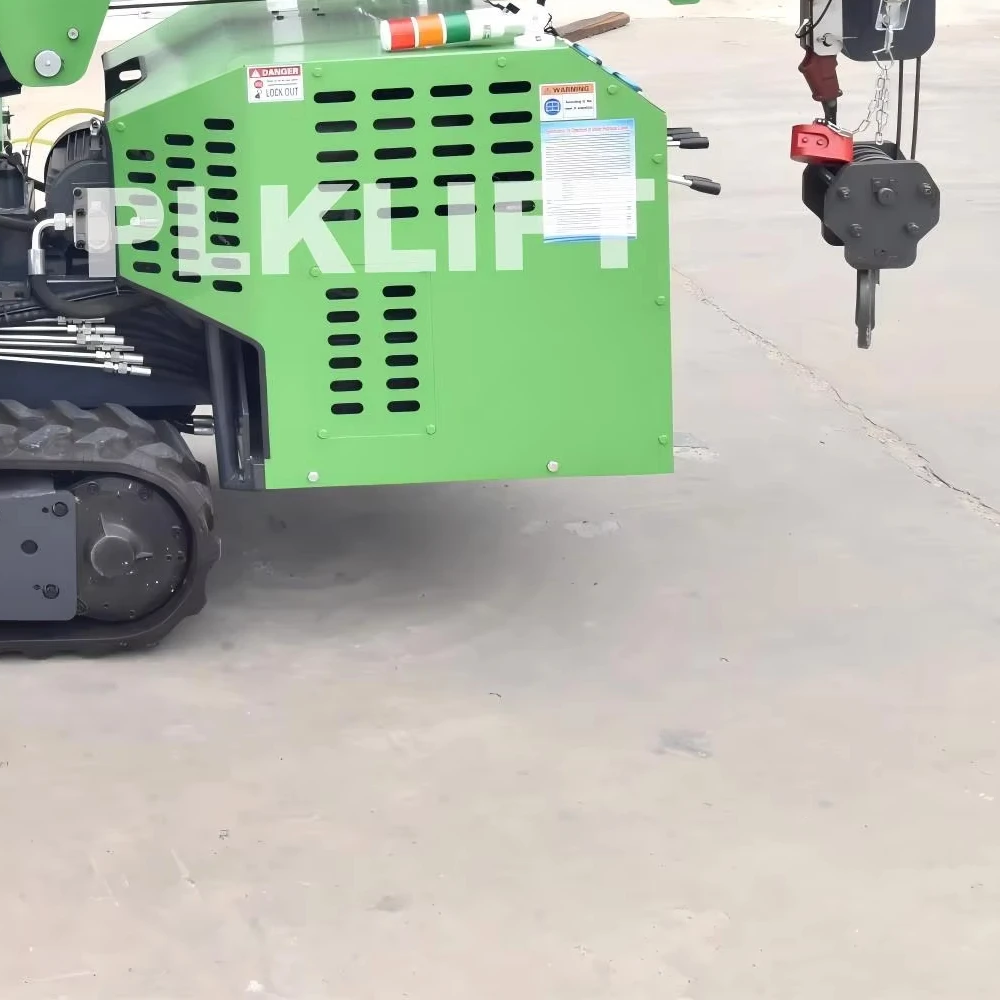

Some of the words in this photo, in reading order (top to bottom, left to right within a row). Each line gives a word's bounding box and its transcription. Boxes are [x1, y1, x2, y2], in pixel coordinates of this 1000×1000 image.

[262, 68, 298, 76] DANGER
[266, 88, 283, 97] LOCK
[285, 87, 298, 96] OUT
[552, 85, 590, 93] WARNING
